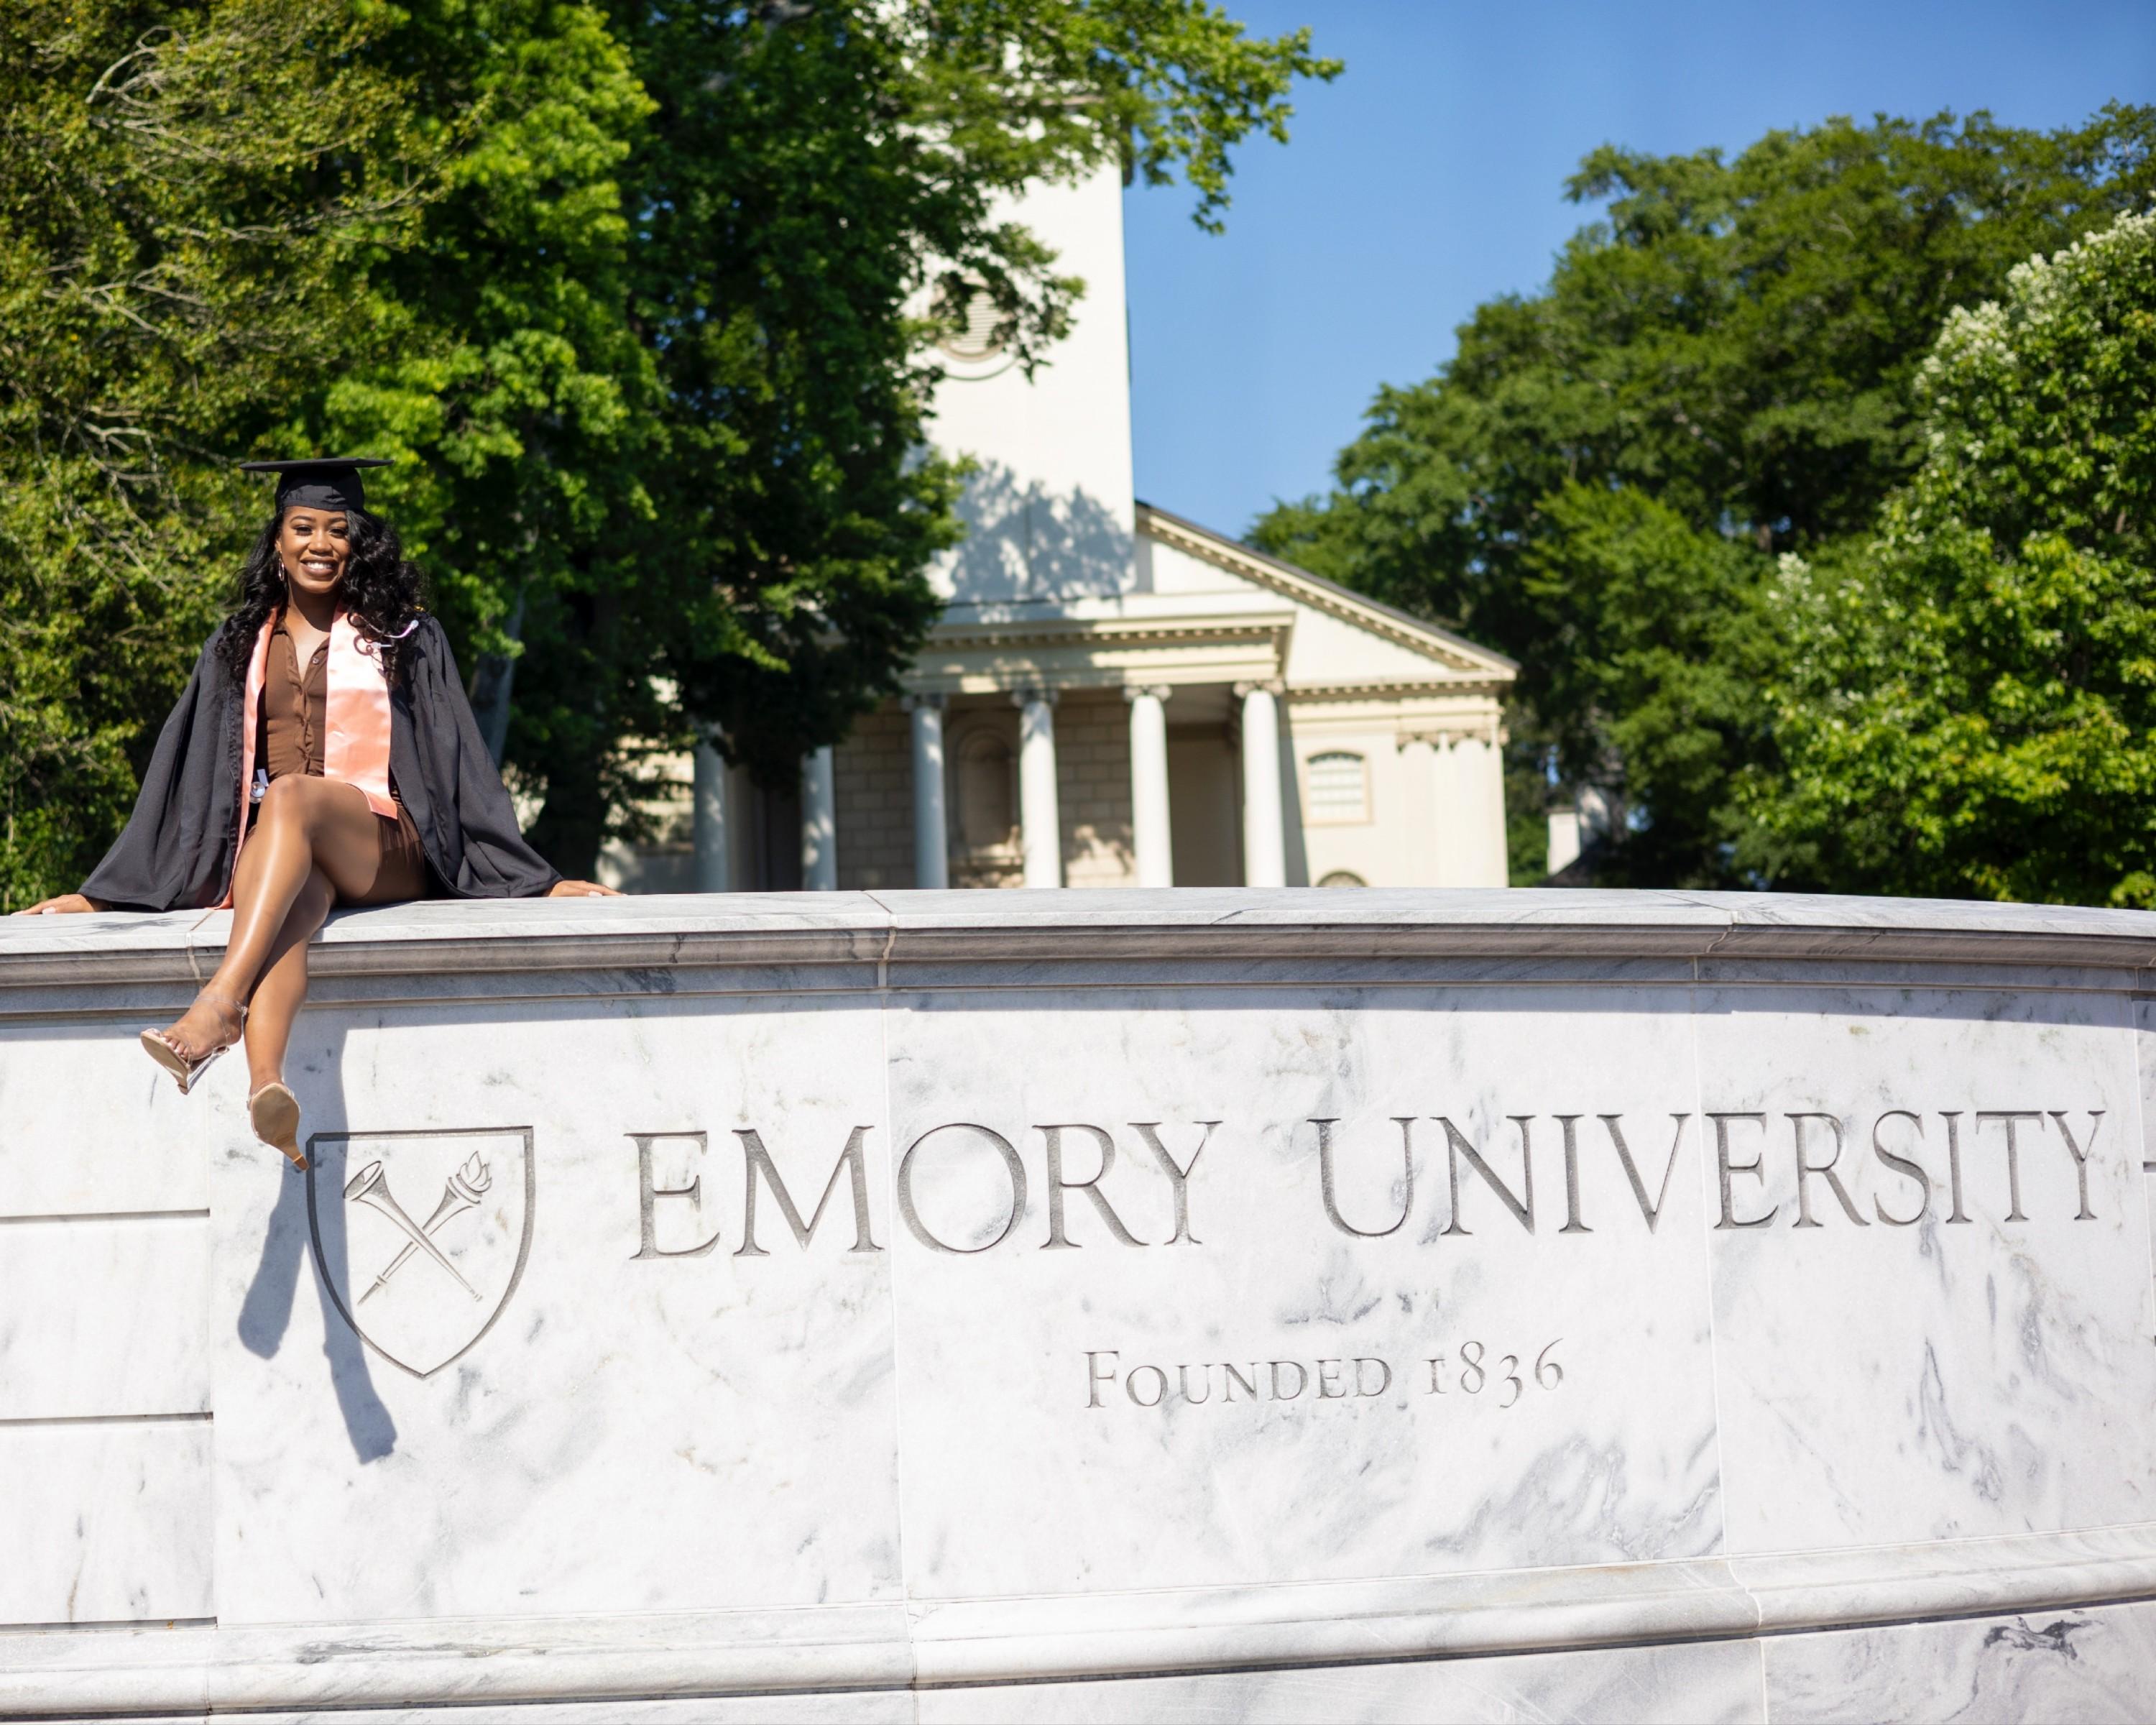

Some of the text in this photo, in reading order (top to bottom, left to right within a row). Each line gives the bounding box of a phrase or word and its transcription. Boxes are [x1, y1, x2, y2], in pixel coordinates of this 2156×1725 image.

[623, 1110, 2106, 1259] EMORY UNIVERSITY
[1422, 1338, 1564, 1409] 1836
